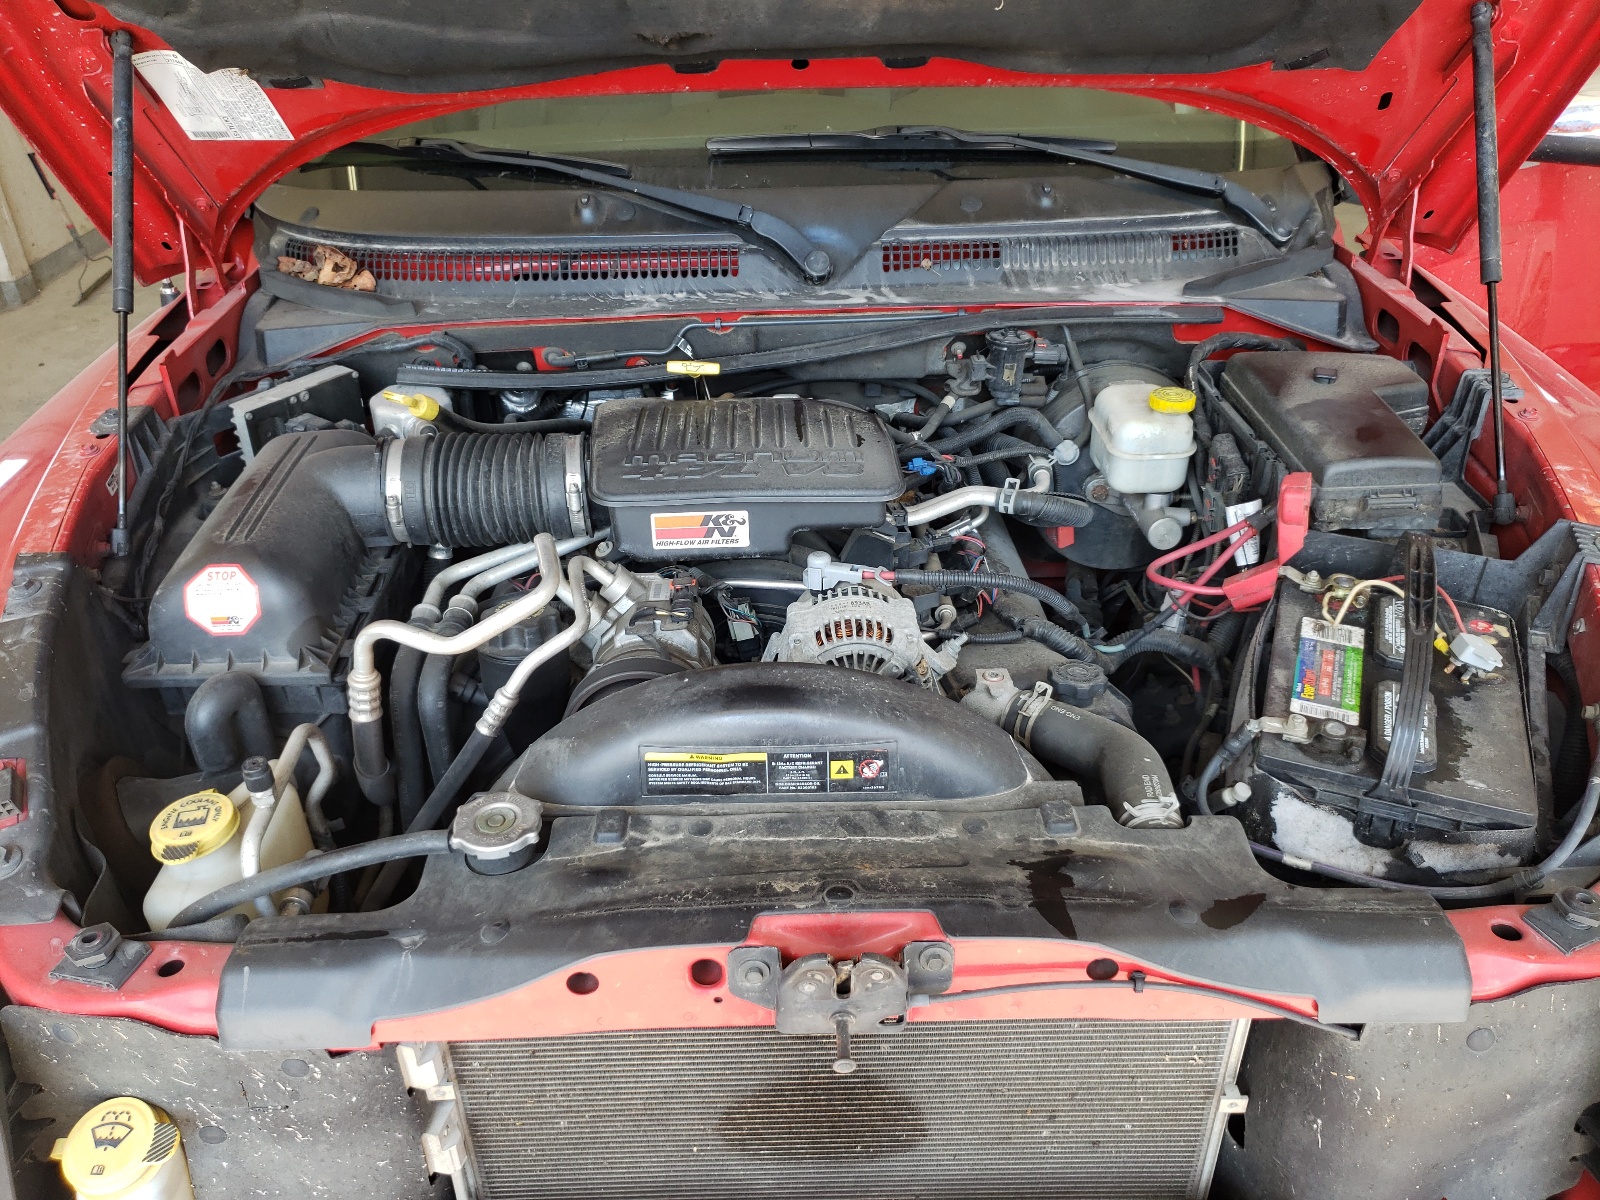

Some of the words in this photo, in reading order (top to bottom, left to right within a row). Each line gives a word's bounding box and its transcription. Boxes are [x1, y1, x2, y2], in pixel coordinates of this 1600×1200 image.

[700, 514, 746, 538] K&N
[207, 571, 237, 581] STOP
[180, 797, 220, 808] COOLANT
